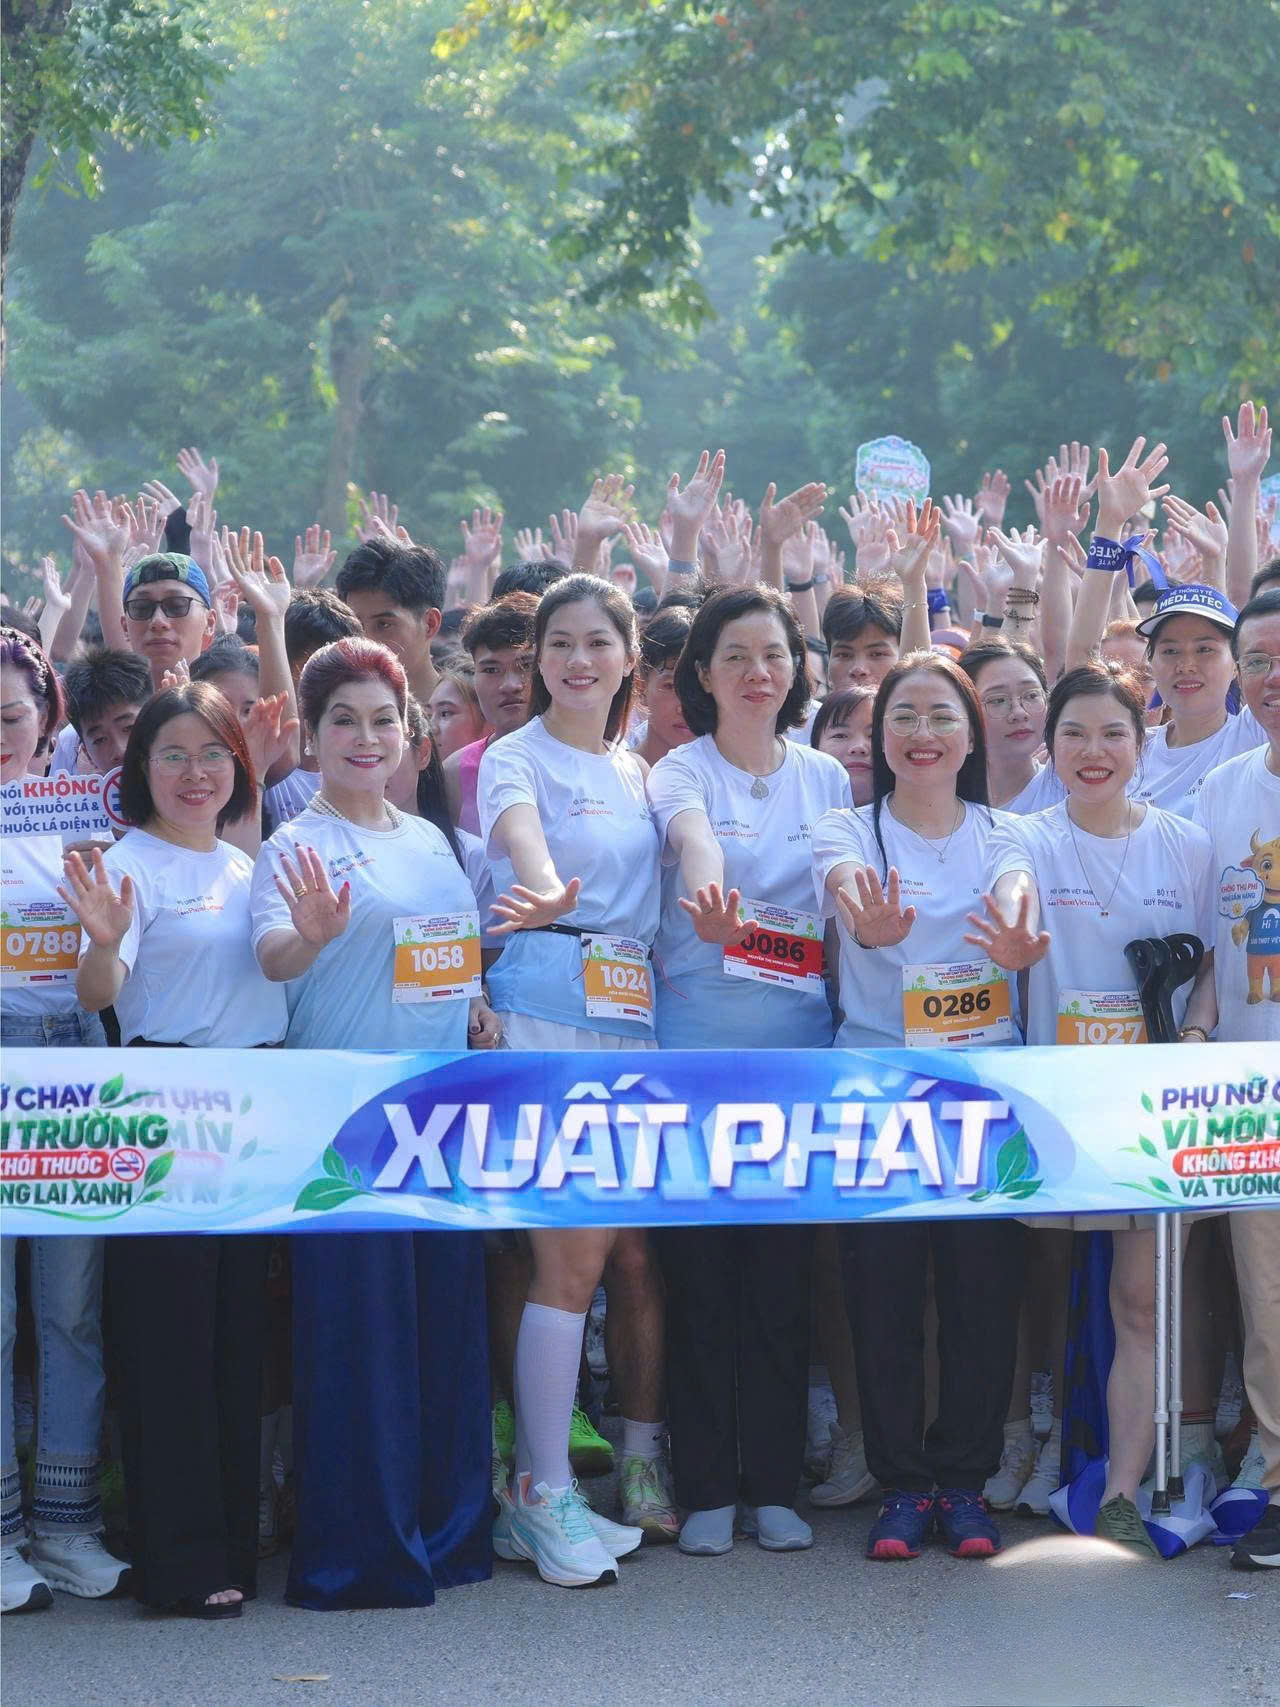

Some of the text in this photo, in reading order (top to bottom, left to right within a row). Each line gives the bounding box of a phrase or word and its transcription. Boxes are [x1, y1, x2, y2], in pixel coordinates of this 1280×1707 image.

[1160, 594, 1222, 610] MEDLATEC
[24, 774, 100, 798] KHÔNG
[4, 797, 99, 816] VỚI THUỐC LÁ &
[0, 814, 109, 833] HUỐC LÁ ĐIỆN TỬ
[6, 931, 77, 956] 0788
[741, 930, 805, 962] 0086
[411, 945, 464, 972] 1058
[600, 966, 648, 994] 1024
[923, 989, 990, 1018] 0286
[1075, 1021, 1144, 1044] 1027
[15, 1083, 96, 1113] CHẠY
[1162, 1085, 1219, 1112] PHỤ
[1226, 1076, 1268, 1106] NỮ
[17, 1104, 168, 1150] TRƯỜNG
[372, 1074, 1011, 1190] XUẤT PHÁT
[1162, 1110, 1199, 1150] VÌ
[1206, 1108, 1267, 1146] MÔI
[41, 1152, 103, 1175] THUỐC
[1182, 1148, 1246, 1173] KHÔNG
[34, 1184, 67, 1205] LAI
[71, 1180, 132, 1205] XANH
[1180, 1174, 1208, 1197] VÀ
